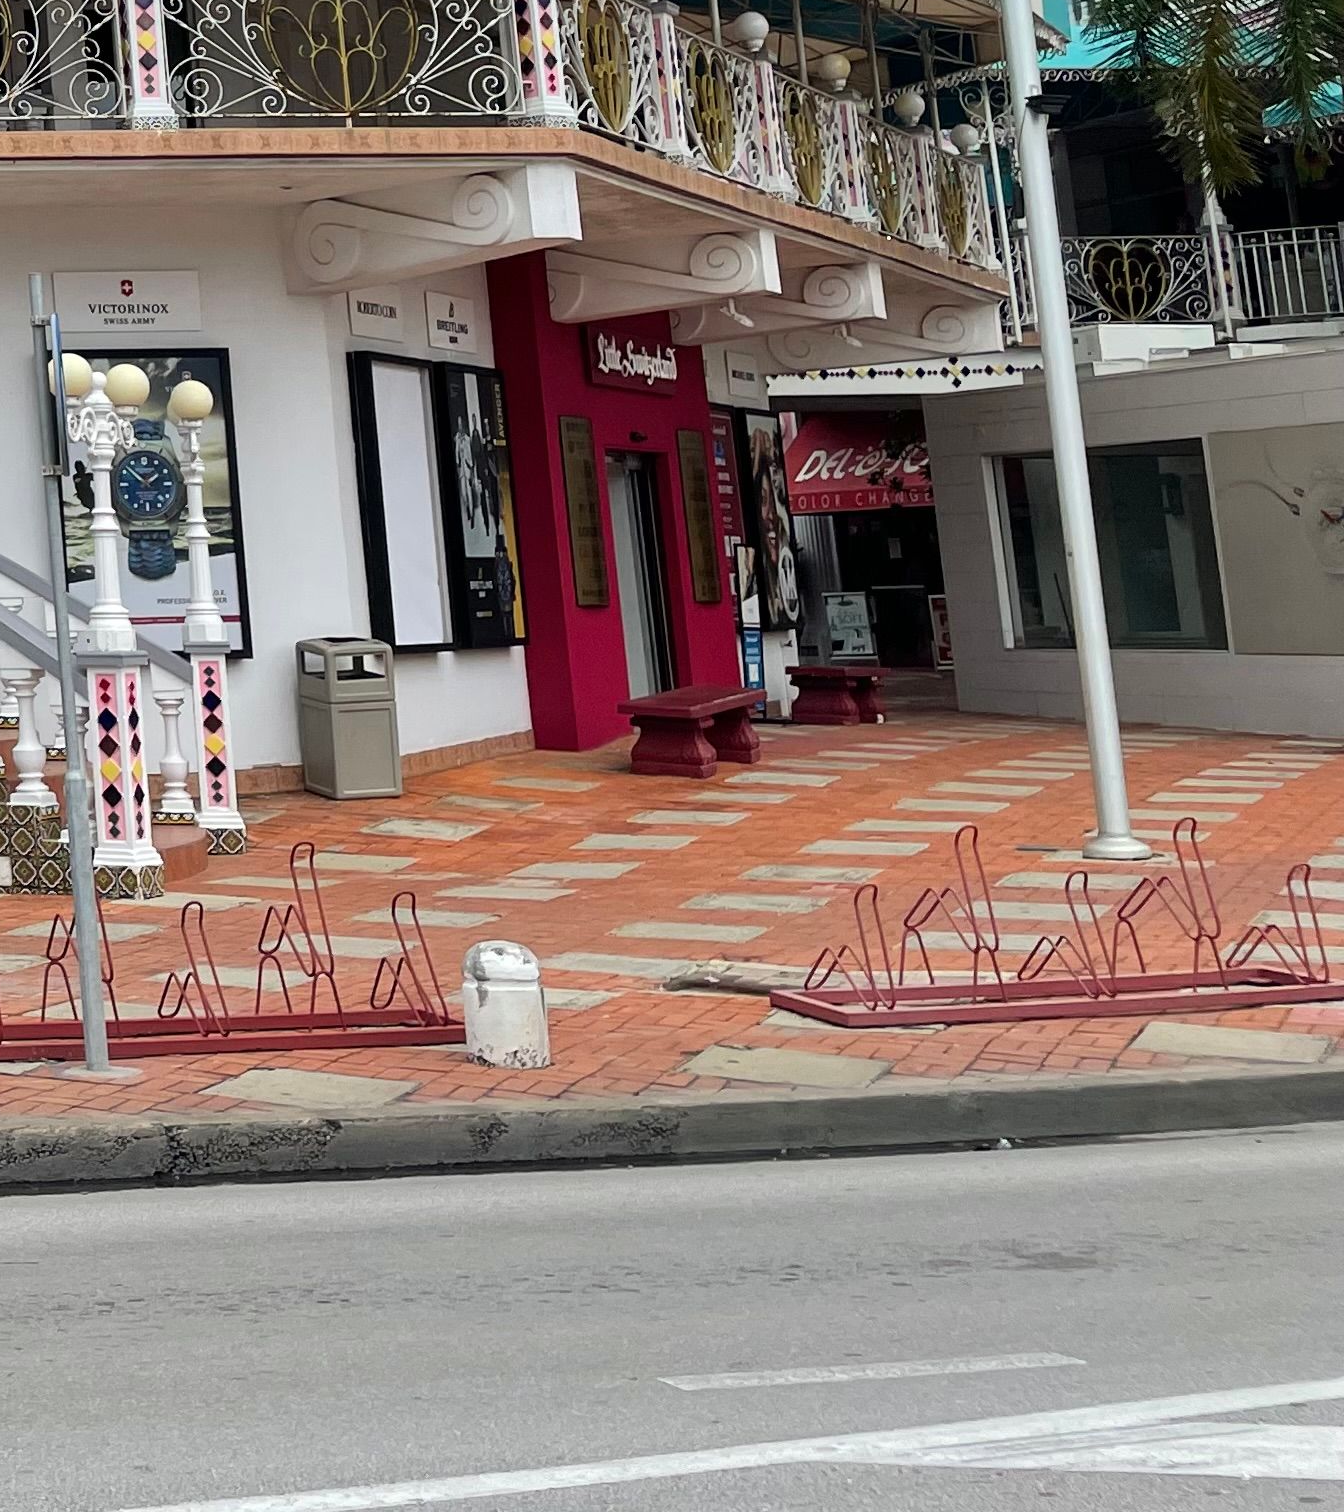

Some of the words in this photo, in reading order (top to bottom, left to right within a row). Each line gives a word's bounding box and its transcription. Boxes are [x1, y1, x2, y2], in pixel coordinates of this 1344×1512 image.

[88, 303, 169, 315] VICTORINOX
[131, 317, 156, 325] ARMY
[436, 319, 468, 334] BREITLING
[597, 332, 622, 374] Little
[621, 340, 678, 385] Switzerland
[156, 597, 192, 605] PROFESSI
